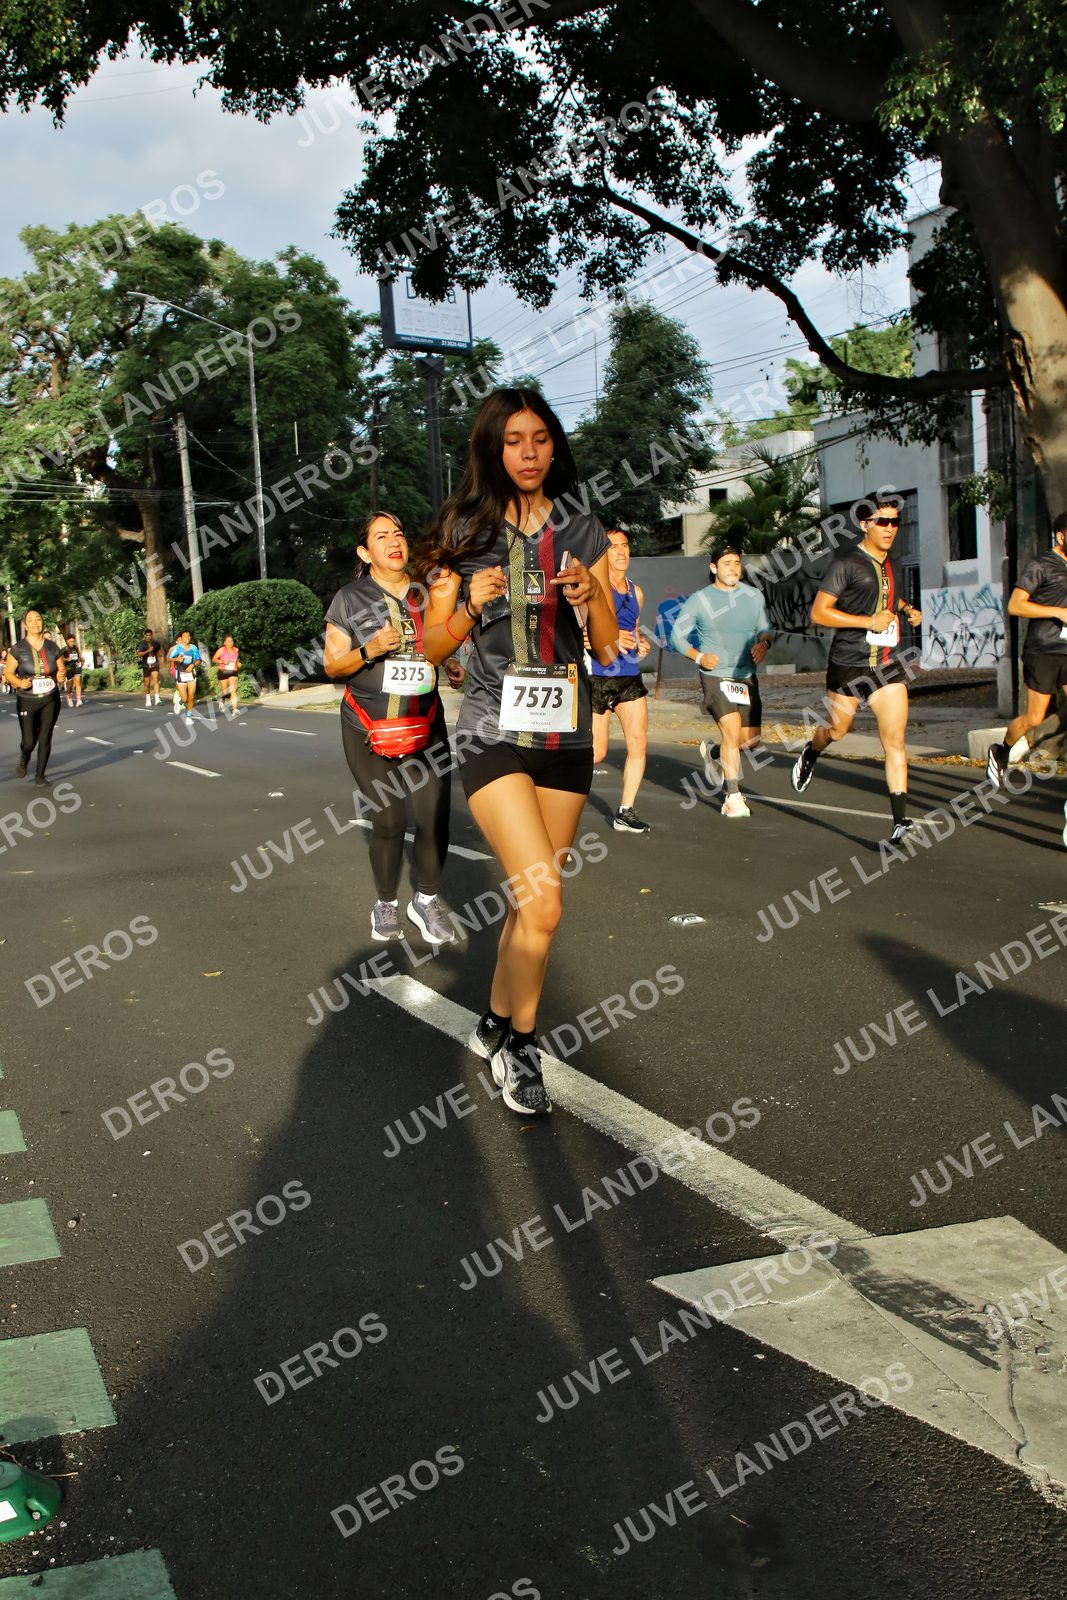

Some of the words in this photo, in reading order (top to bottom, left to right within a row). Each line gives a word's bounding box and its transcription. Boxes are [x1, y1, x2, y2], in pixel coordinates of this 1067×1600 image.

[391, 666, 425, 682] 2375
[513, 685, 563, 709] 7573
[726, 685, 744, 695] 1009
